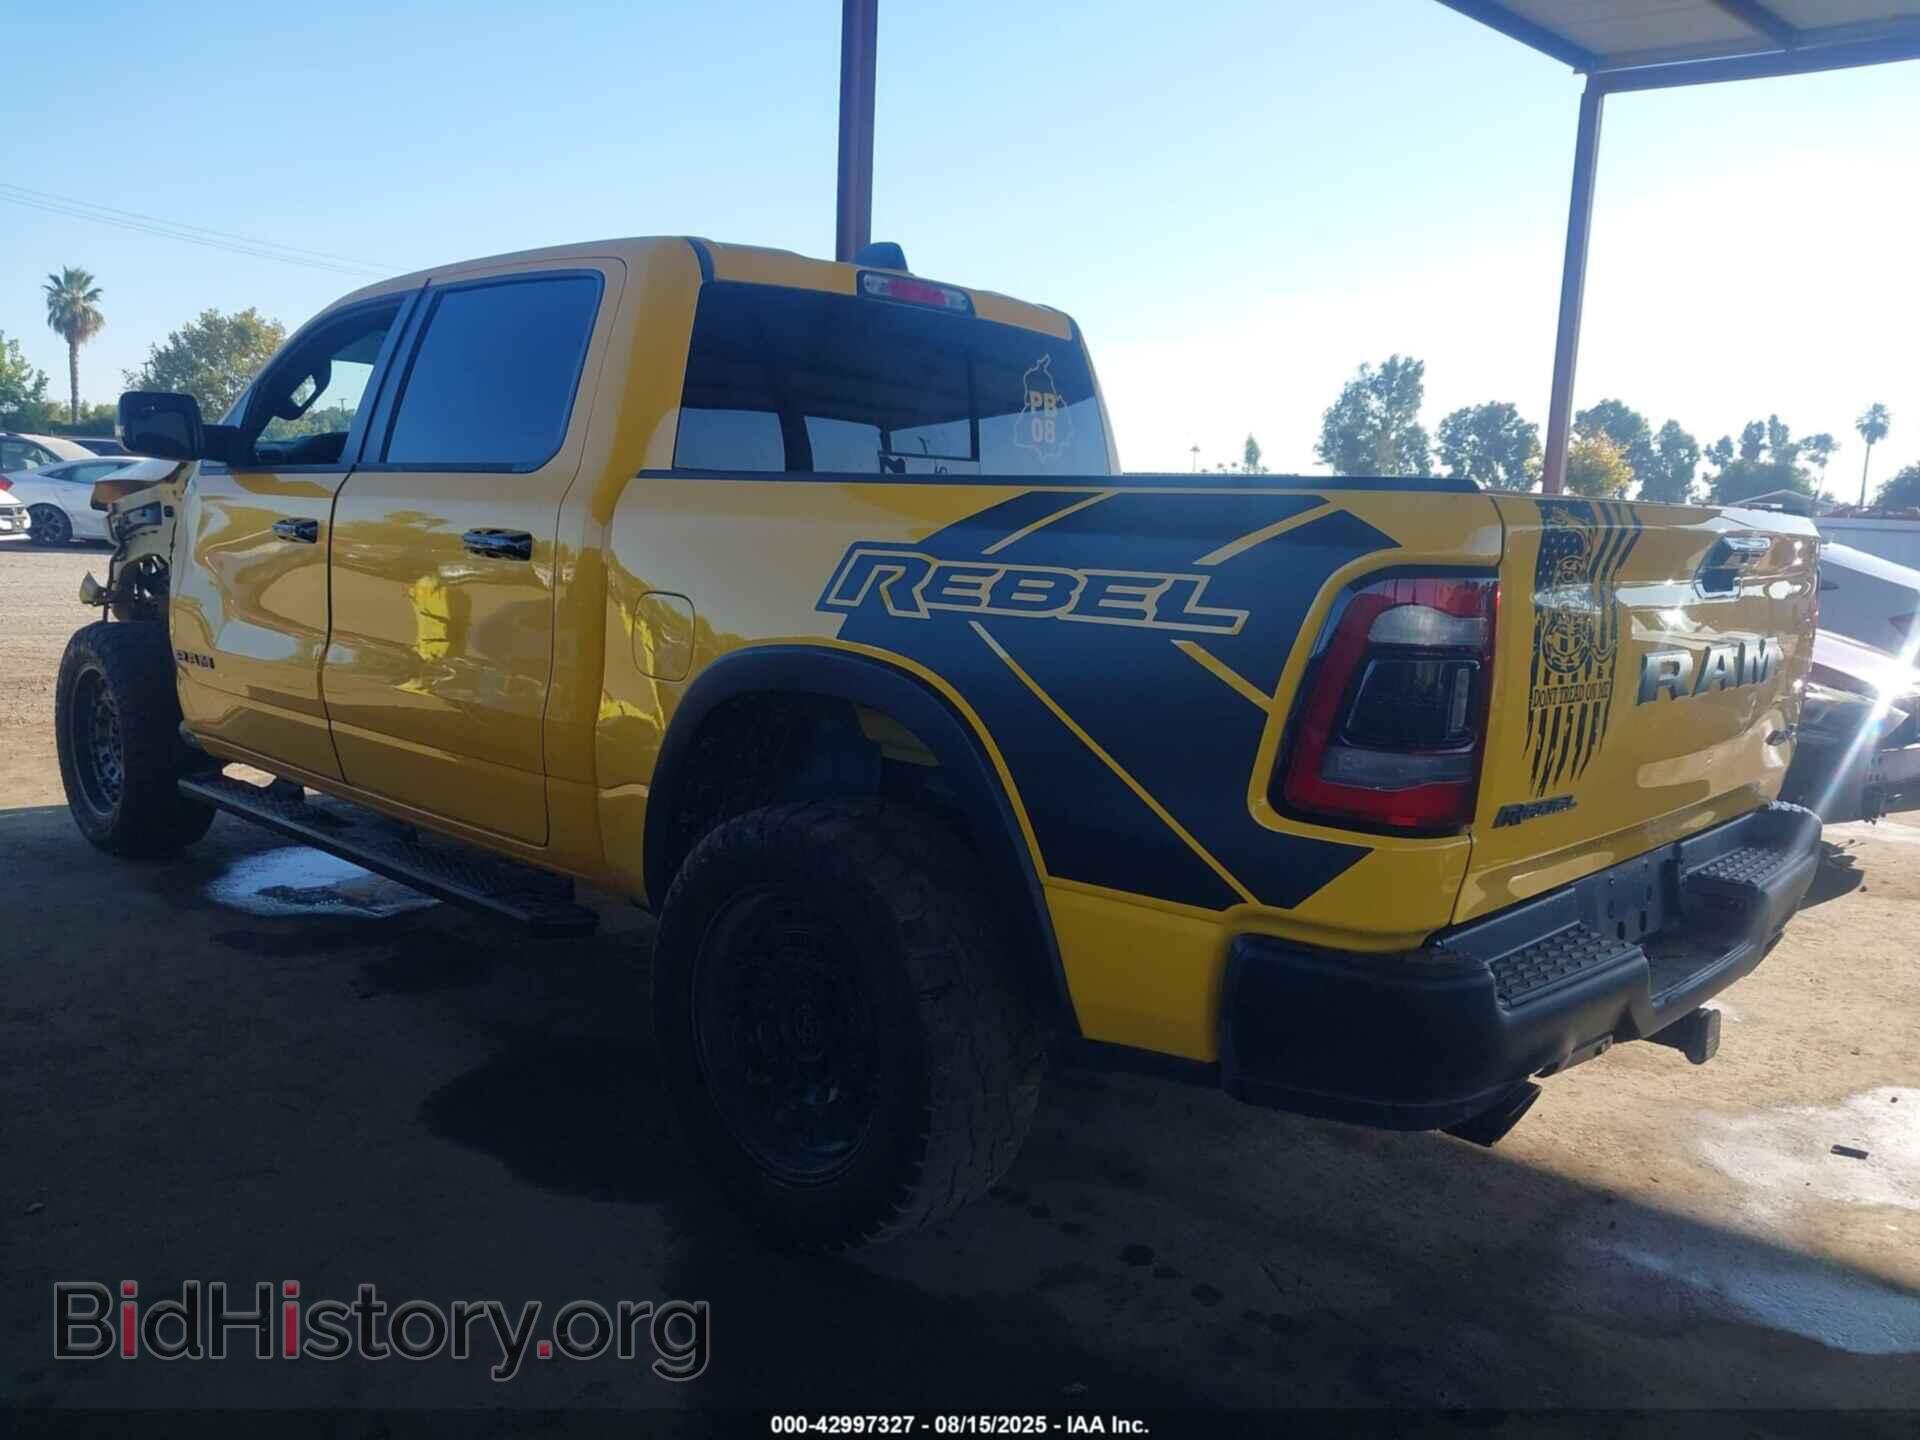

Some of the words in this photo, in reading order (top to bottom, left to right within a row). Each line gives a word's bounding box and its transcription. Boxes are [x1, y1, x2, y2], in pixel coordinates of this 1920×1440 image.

[1030, 391, 1056, 416] PB
[1031, 417, 1056, 443] 08
[826, 548, 1249, 635] REBEL
[1637, 637, 1778, 706] RAM
